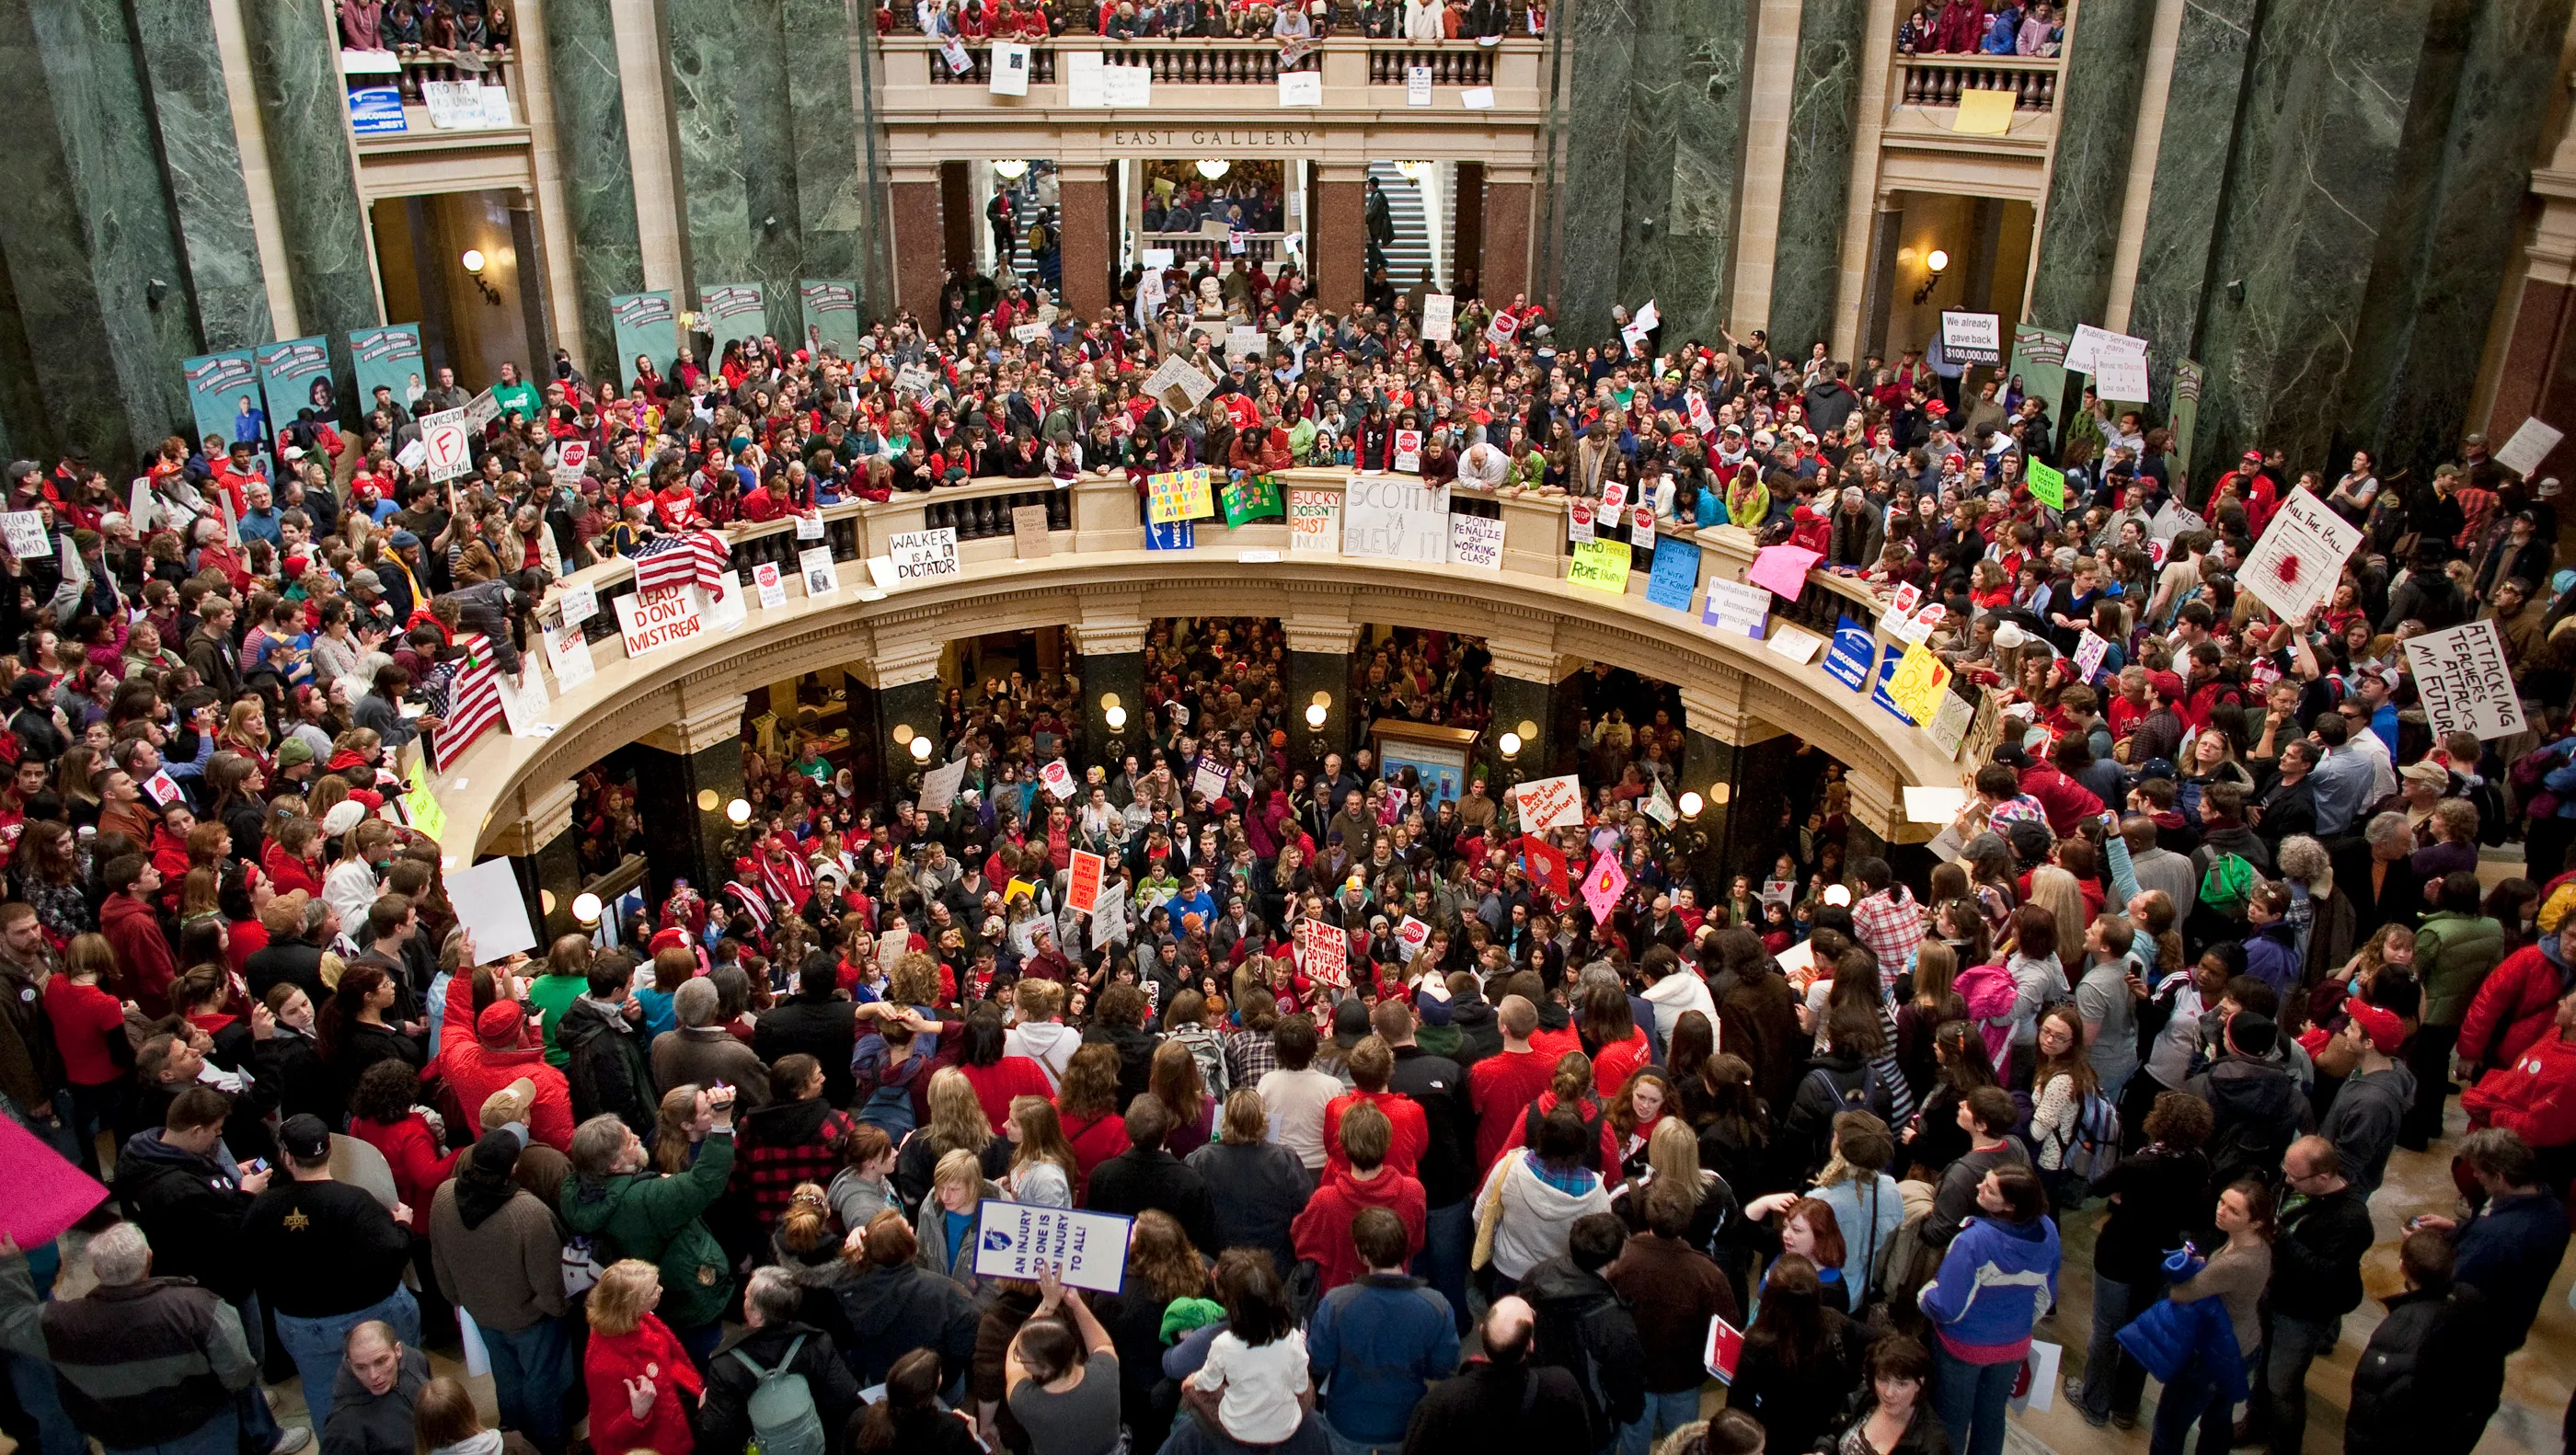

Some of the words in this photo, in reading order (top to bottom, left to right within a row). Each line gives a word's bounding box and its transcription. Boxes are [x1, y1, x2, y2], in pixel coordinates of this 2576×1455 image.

[456, 83, 470, 95] TA
[454, 97, 478, 108] UNION
[1115, 130, 1175, 145] EAST
[1191, 130, 1312, 145] GALLERY
[1429, 305, 1449, 314] PUBLIC
[1496, 317, 1512, 329] STOP
[1946, 316, 1959, 327] We
[1961, 317, 1992, 329] already
[1950, 335, 1970, 346] gave
[1972, 335, 1992, 345] back
[2081, 327, 2106, 340] Public
[2108, 335, 2143, 349] Servants
[270, 347, 291, 363] MAKING
[294, 345, 316, 355] HISTORY
[1946, 349, 1999, 362] $100,000,000
[2106, 344, 2124, 353] earn
[197, 361, 217, 378] MAKING
[220, 358, 243, 369] HISTORY
[280, 358, 299, 371] MAKING
[299, 352, 320, 365] FUTURES
[206, 373, 225, 387] MAKING
[224, 367, 247, 380] FUTURES
[1146, 364, 1171, 390] SCOTT
[1181, 372, 1193, 383] IS
[1184, 375, 1202, 395] FULL
[422, 414, 451, 429] CIVICS
[451, 410, 463, 422] 101
[436, 431, 452, 463] F
[1399, 437, 1417, 447] STOP
[565, 450, 585, 461] STOP
[431, 466, 449, 480] YOU
[451, 463, 471, 476] FAIL
[1258, 475, 1273, 485] WE
[2035, 464, 2055, 480] RECALL
[1153, 484, 1167, 495] DO
[1170, 482, 1184, 493] MY
[1605, 489, 1622, 500] STOP
[1150, 495, 1172, 507] FOR
[1174, 493, 1189, 503] MY
[1292, 491, 1340, 505] BUCKY
[1386, 511, 1404, 530] YA
[1573, 510, 1591, 520] STOP
[1636, 512, 1652, 522] STOP
[2177, 509, 2196, 526] WE
[1292, 518, 1328, 533] BUST
[1454, 523, 1501, 540] PENALIZE
[890, 530, 950, 550] WALKER
[1291, 533, 1332, 550] UNIONS
[1347, 527, 1404, 556] BLEW
[1420, 531, 1443, 559] IT
[1454, 541, 1496, 556] WORKING
[911, 553, 921, 563] IS
[924, 551, 933, 561] A
[1577, 540, 1604, 554] NERO
[1605, 543, 1630, 558] FIDDLES
[1460, 552, 1490, 566] CLASS
[1593, 556, 1613, 567] WHILE
[760, 571, 776, 582] STOP
[898, 558, 957, 579] DICTATOR
[1571, 561, 1600, 580] ROME
[1601, 569, 1626, 584] BURNS
[1653, 574, 1669, 585] THE
[637, 586, 679, 609] LEAD
[1710, 580, 1750, 598] Absolutism
[1752, 590, 1758, 599] is
[1759, 592, 1770, 604] not
[1898, 592, 1914, 605] STOP
[1723, 600, 1762, 617] democratic
[1921, 608, 1939, 620] STOP
[1719, 611, 1753, 627] principle
[628, 614, 701, 653] MISTREAT
[1830, 646, 1868, 678] WISCONSIN
[1907, 648, 1930, 671] WE
[2409, 644, 2438, 668] MY
[2448, 629, 2488, 704] TEACHERS
[1843, 670, 1863, 688] BEST
[2466, 624, 2516, 728] ATTACKING
[1901, 670, 1930, 703] OUR
[2443, 659, 2478, 731] ATTACKS
[1888, 677, 1936, 728] TEACHERS
[2421, 675, 2457, 737] FUTURE
[1046, 766, 1064, 781] STOP
[1199, 758, 1229, 777] SEIU
[159, 783, 177, 803] STOP
[1518, 785, 1546, 808] Don't
[1535, 794, 1577, 829] Education!
[1077, 856, 1097, 866] UNITED
[1074, 870, 1098, 881] BARGAIN
[1074, 882, 1095, 893] DIVIDED
[1076, 898, 1088, 906] BEG
[1030, 922, 1046, 931] IRON
[1306, 920, 1314, 934] 2
[1316, 922, 1342, 943] DAYS
[1404, 926, 1423, 939] STOP
[881, 939, 905, 949] CREATOR
[882, 932, 898, 943] JOB
[1308, 934, 1346, 957] FORWARD
[1307, 947, 1318, 961] 50
[1317, 950, 1345, 971] YEARS
[1311, 961, 1340, 985] BACK
[1043, 1213, 1051, 1226] IS
[1018, 1209, 1032, 1255] INJURY
[1053, 1213, 1069, 1260] INJURY
[1076, 1226, 1087, 1254] ALL!
[1036, 1228, 1049, 1254] ONE
[1015, 1255, 1027, 1275] AN
[1033, 1255, 1045, 1274] TO
[1070, 1255, 1083, 1272] TO
